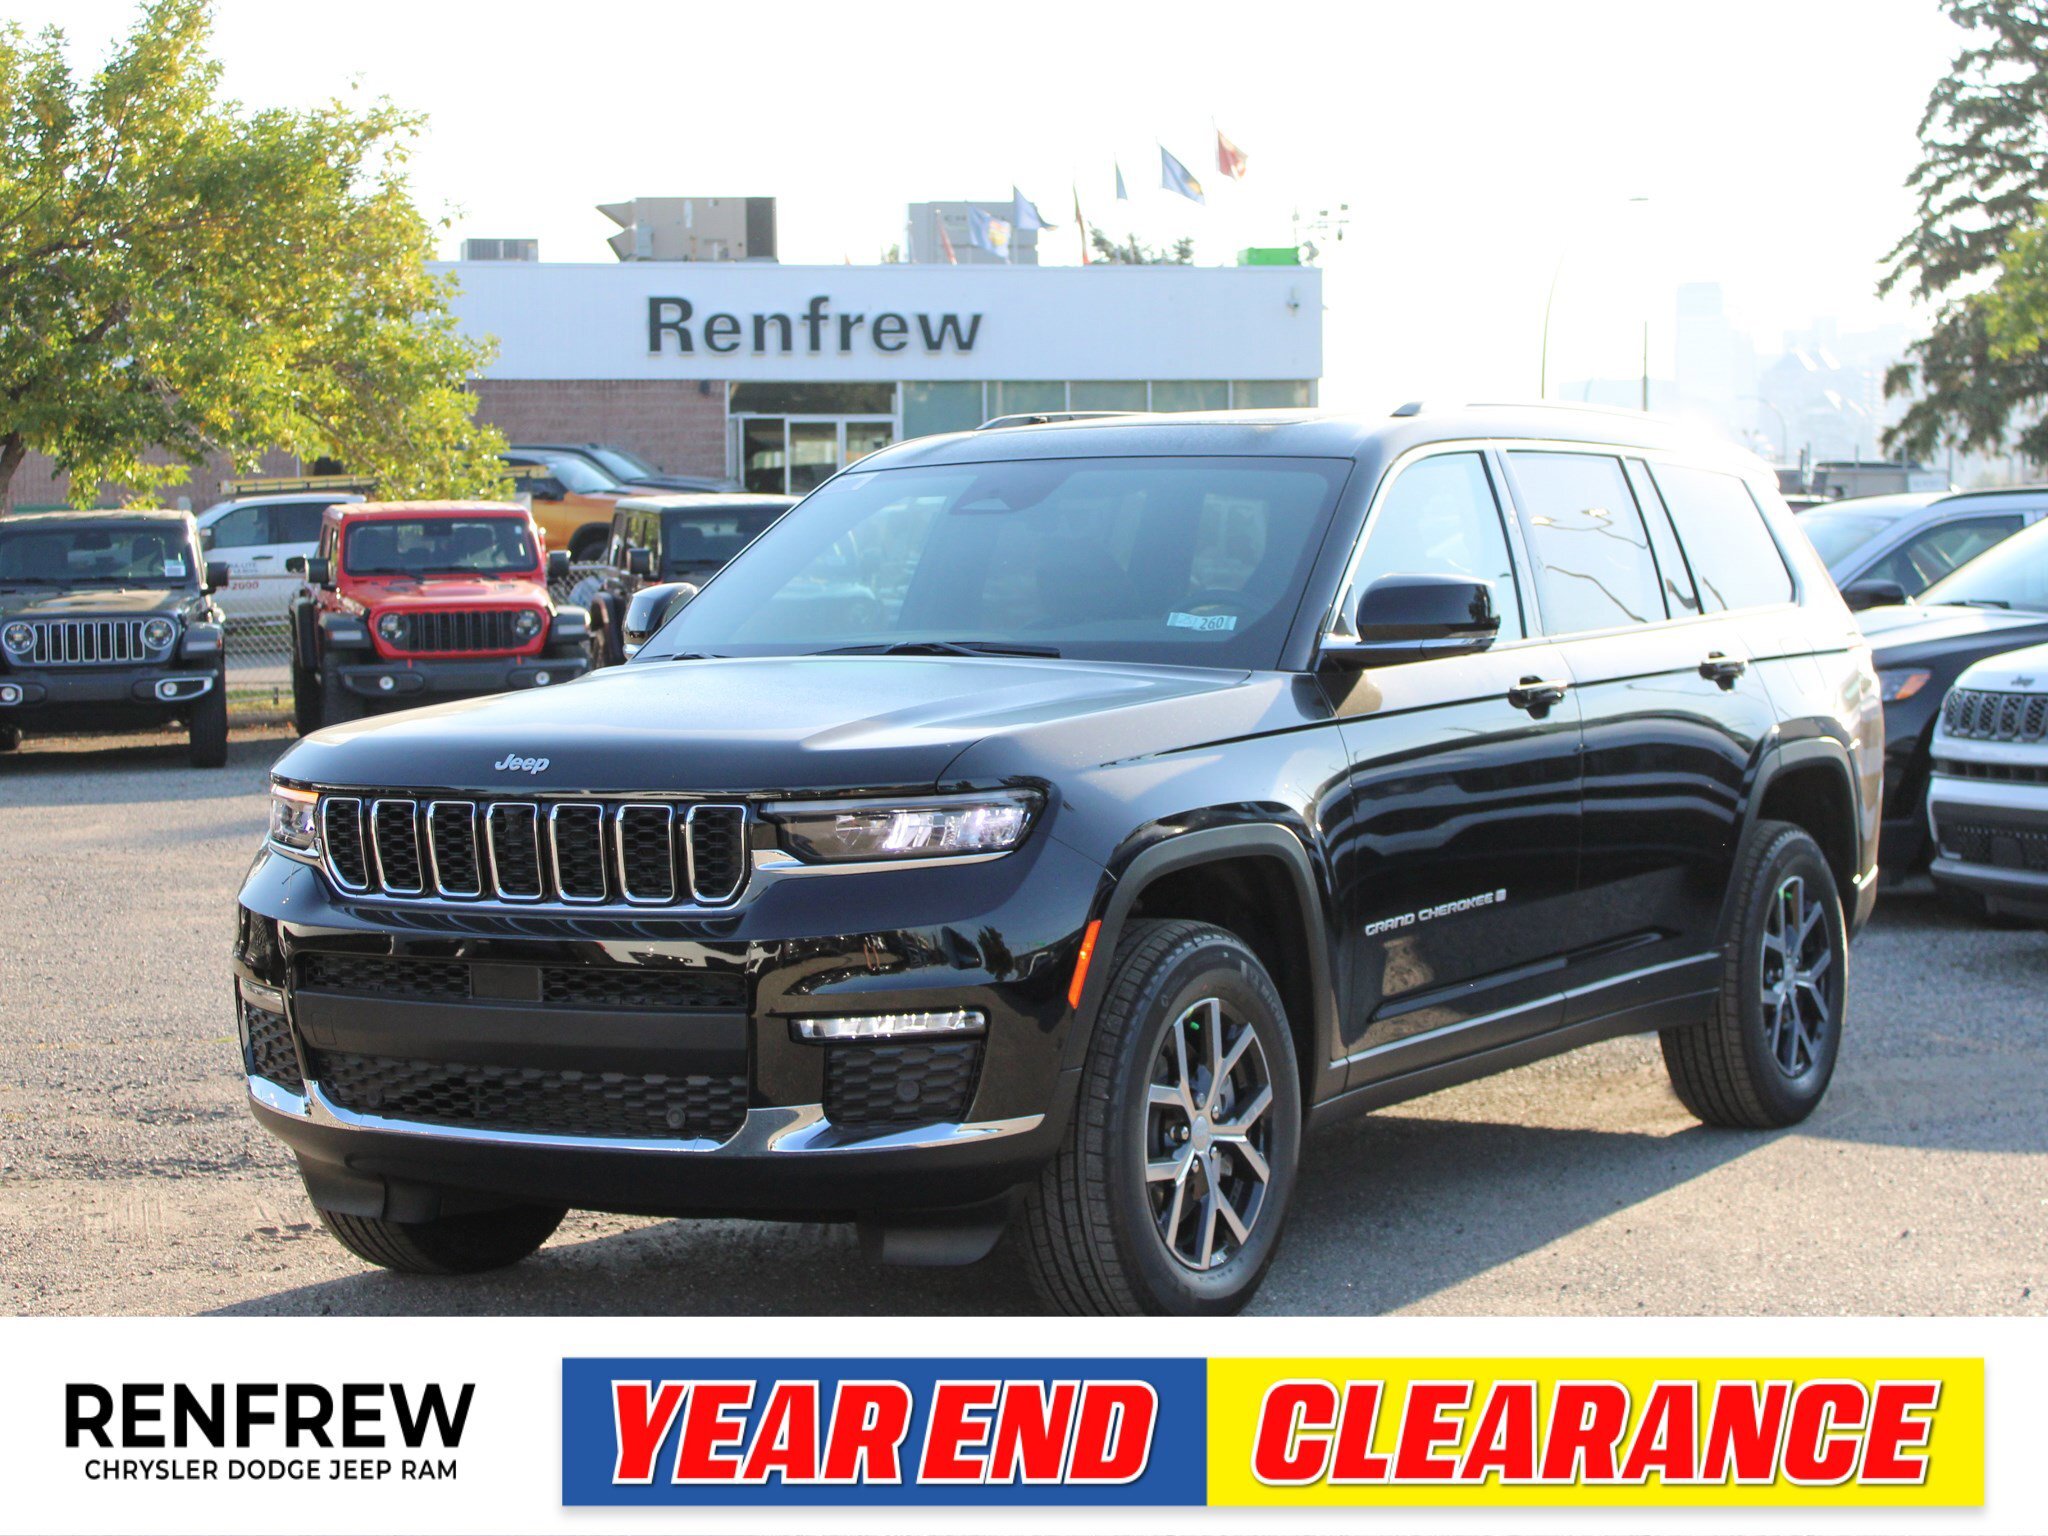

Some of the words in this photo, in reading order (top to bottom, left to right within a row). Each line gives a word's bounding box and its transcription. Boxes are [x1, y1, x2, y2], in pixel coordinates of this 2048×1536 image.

[648, 296, 982, 353] Renfrew
[495, 753, 550, 775] Jeep
[1365, 913, 1415, 936] GRAND
[1418, 892, 1494, 921] CHEROKEE
